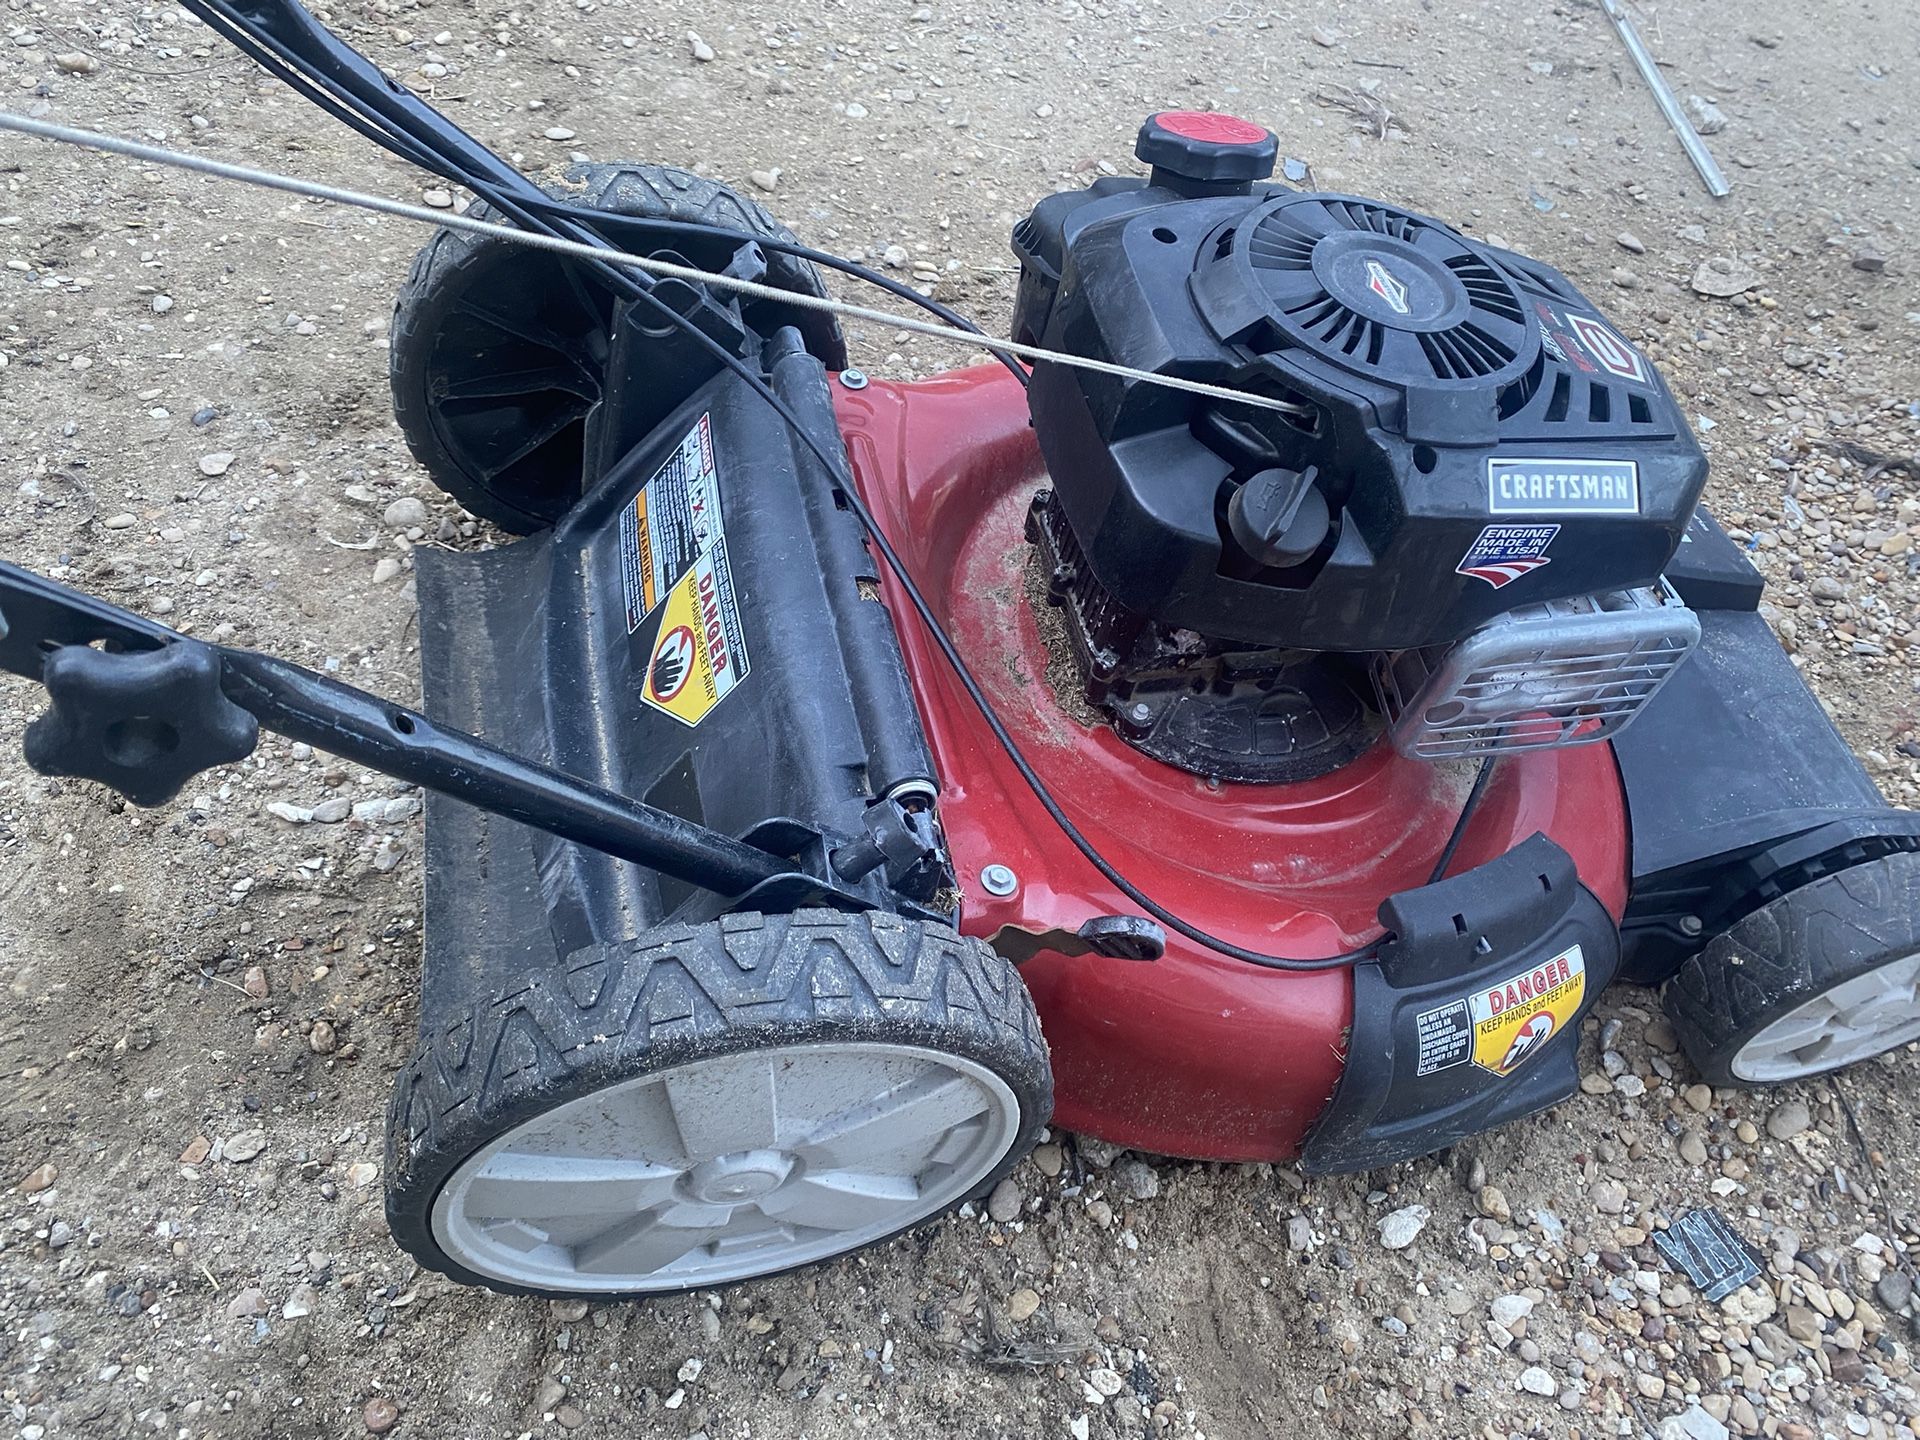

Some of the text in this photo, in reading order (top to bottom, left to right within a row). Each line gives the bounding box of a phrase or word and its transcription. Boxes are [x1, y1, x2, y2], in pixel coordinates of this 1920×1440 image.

[700, 427, 711, 474] DANGER
[1500, 474, 1628, 499] CRAFTSMAN
[1478, 538, 1547, 547] MADE IN
[1484, 529, 1553, 538] ENGINE
[640, 528, 651, 584] WARNING
[1474, 547, 1539, 555] THE USA
[688, 575, 697, 599] KEEP
[690, 600, 702, 631] HANDS
[698, 572, 727, 677] DANGER
[698, 645, 709, 673] FEET
[703, 672, 715, 701] AWAY
[1488, 957, 1571, 1015] DANGER
[1419, 1002, 1464, 1025] DO NOT OPERATE
[1480, 974, 1582, 1035] KEEP HANDS and FEET AWAY
[1421, 1017, 1451, 1034] UNLESS AN
[1421, 1024, 1456, 1042] UNDAMAGED
[1422, 1028, 1468, 1050] DISCHARGE COVER
[1422, 1038, 1466, 1058] OR ENTIRE GRASS
[1421, 1053, 1445, 1066] CATCHER
[1453, 1048, 1459, 1056] IN
